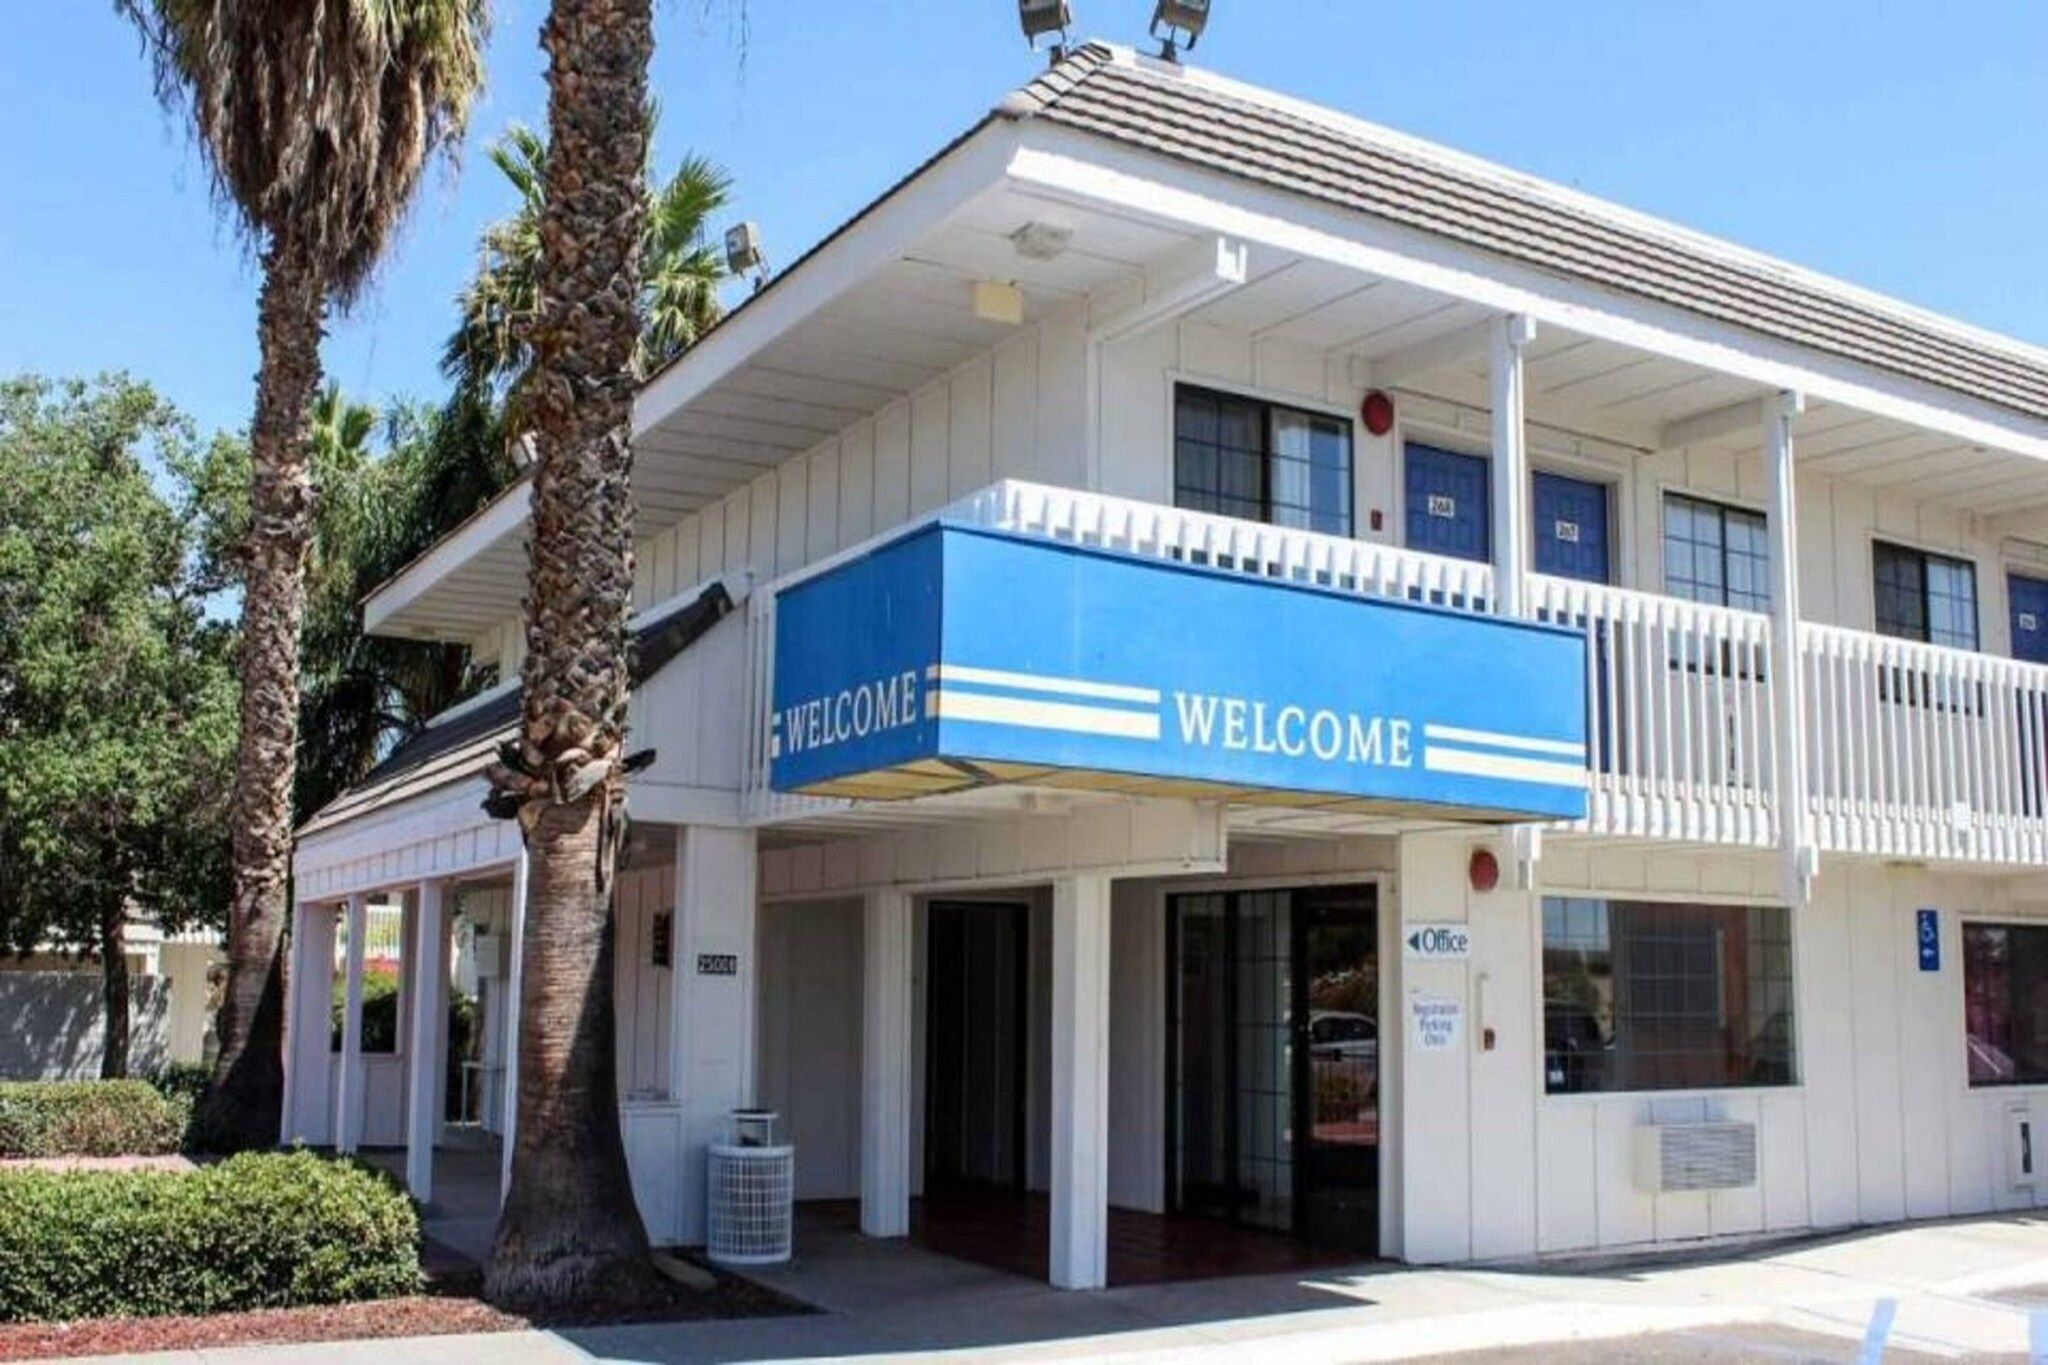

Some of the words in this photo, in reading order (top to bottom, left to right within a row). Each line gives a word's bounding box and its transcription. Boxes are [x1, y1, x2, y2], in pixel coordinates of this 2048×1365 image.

[786, 670, 917, 754] WELCOME
[1174, 691, 1414, 768] WELCOME
[1422, 928, 1468, 952] Office
